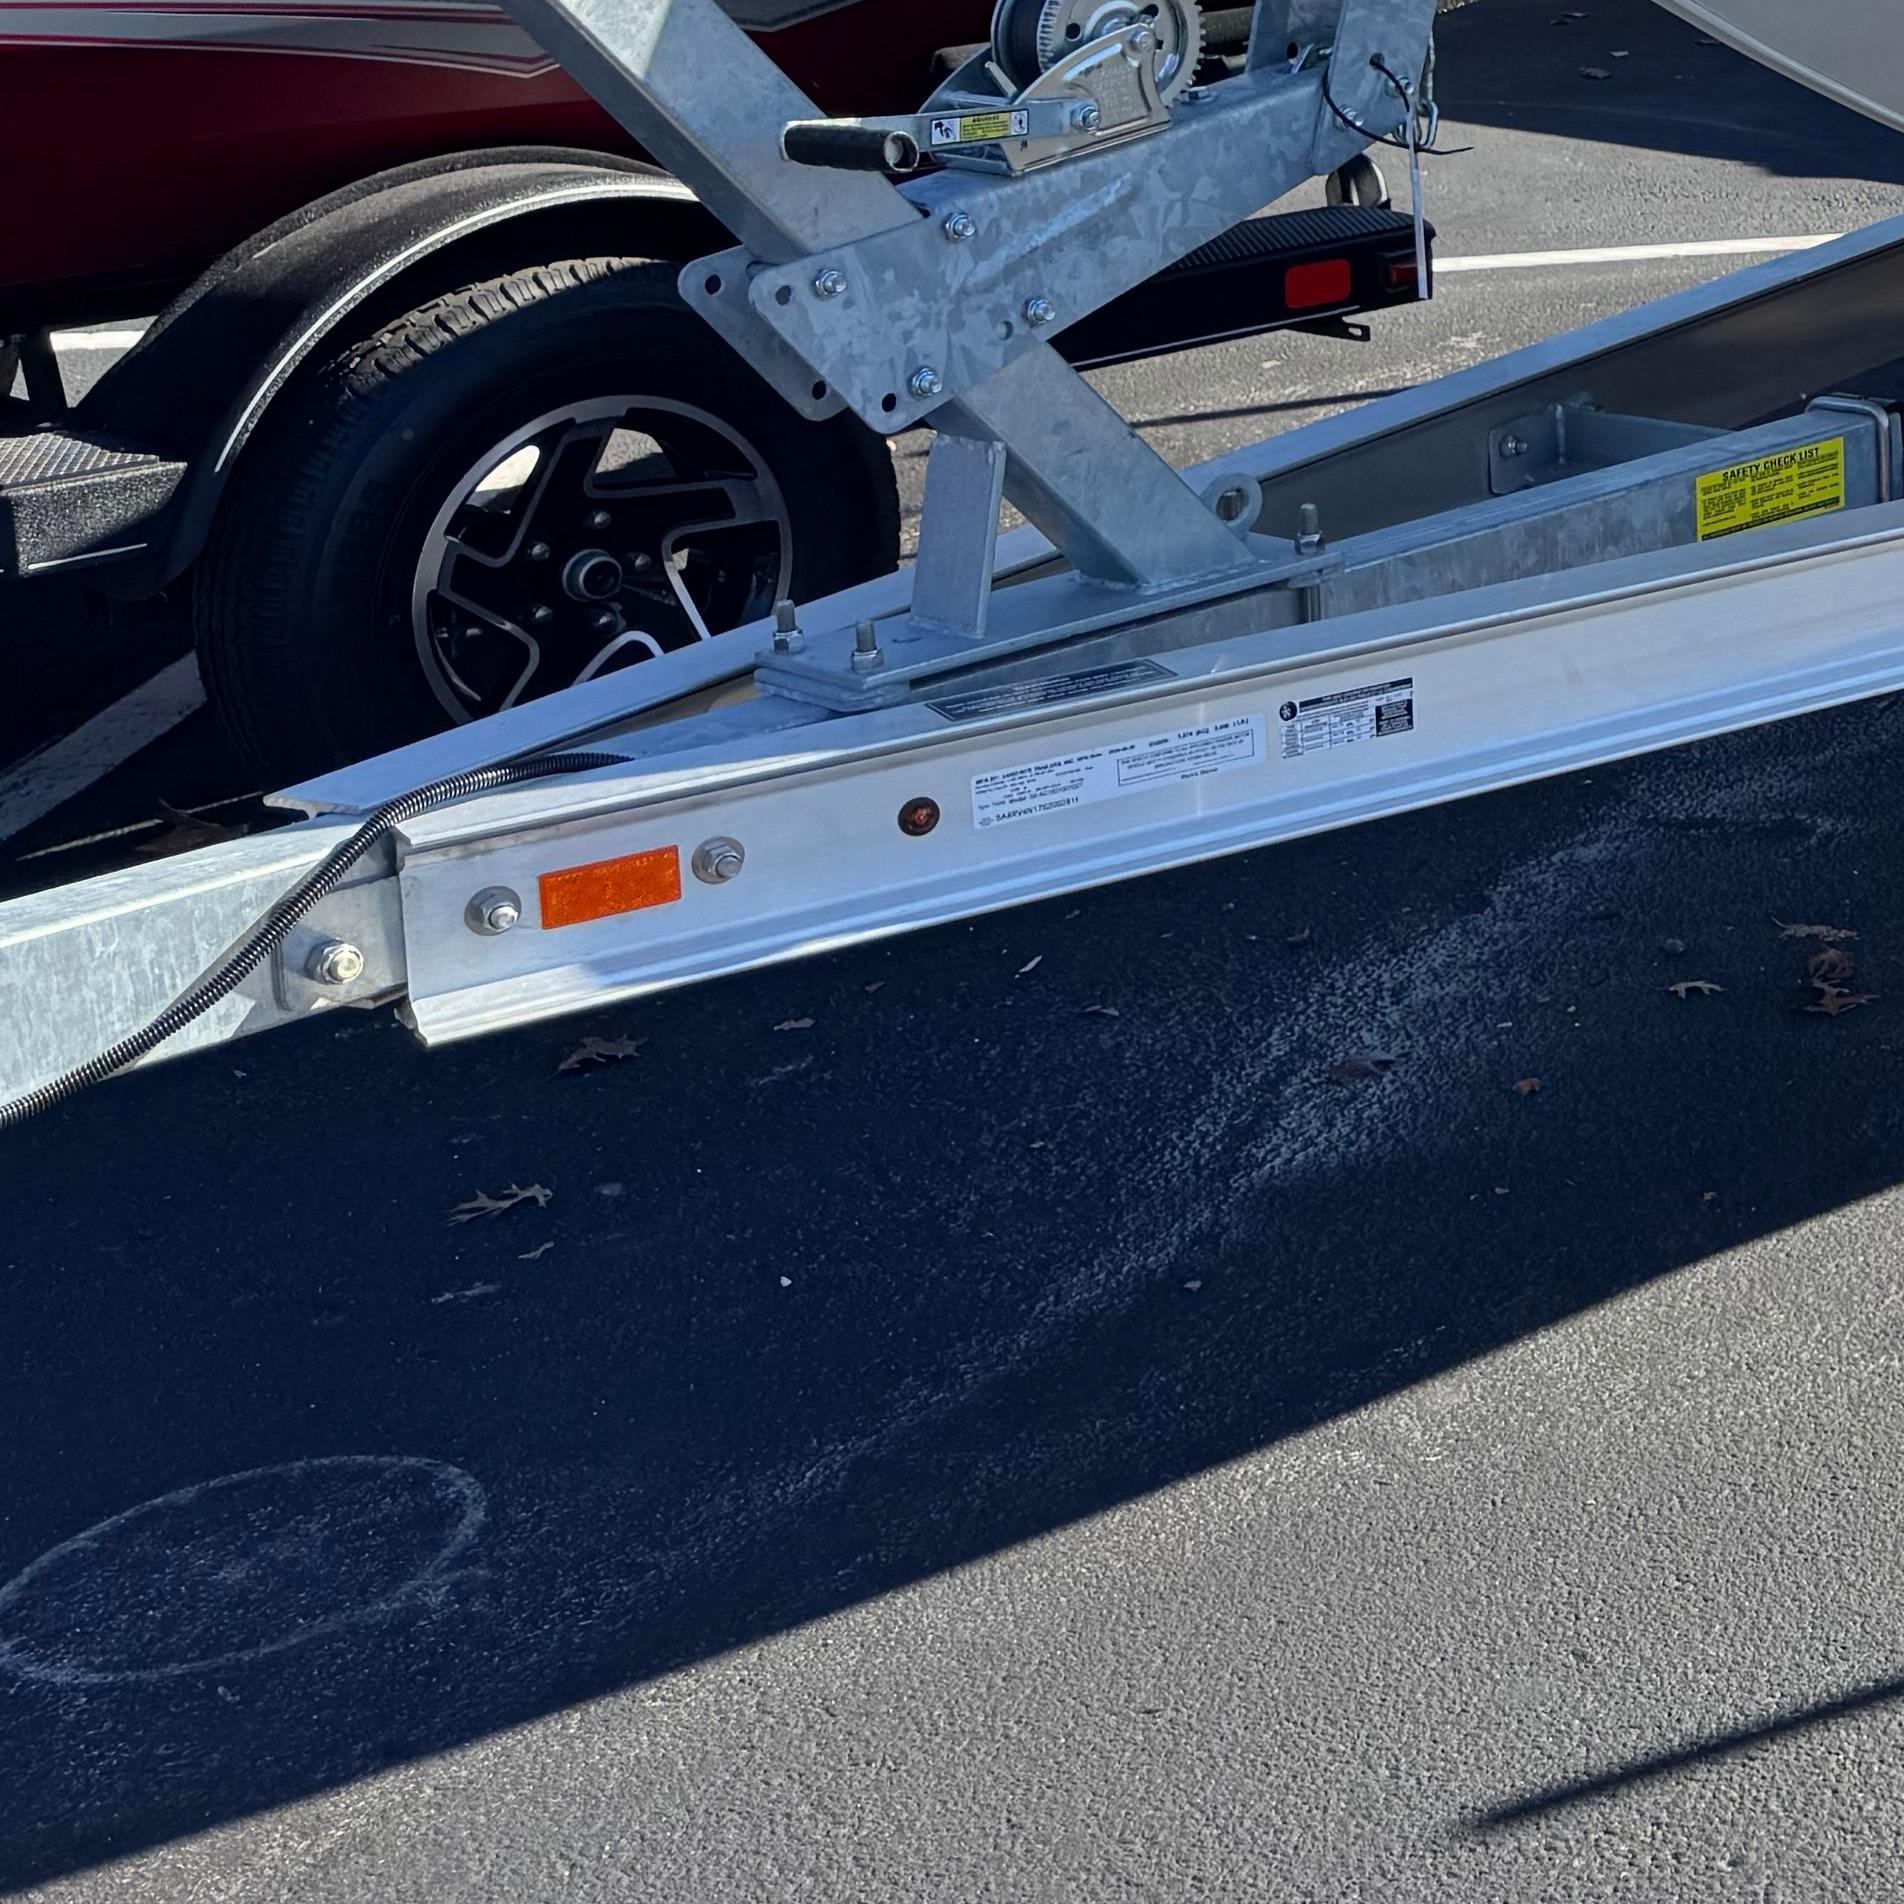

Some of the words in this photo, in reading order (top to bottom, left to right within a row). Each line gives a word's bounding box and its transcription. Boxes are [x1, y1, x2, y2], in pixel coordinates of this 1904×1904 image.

[1722, 463, 1764, 481] SAFETY
[1764, 452, 1797, 471] CHECK
[1798, 447, 1821, 463] LIST
